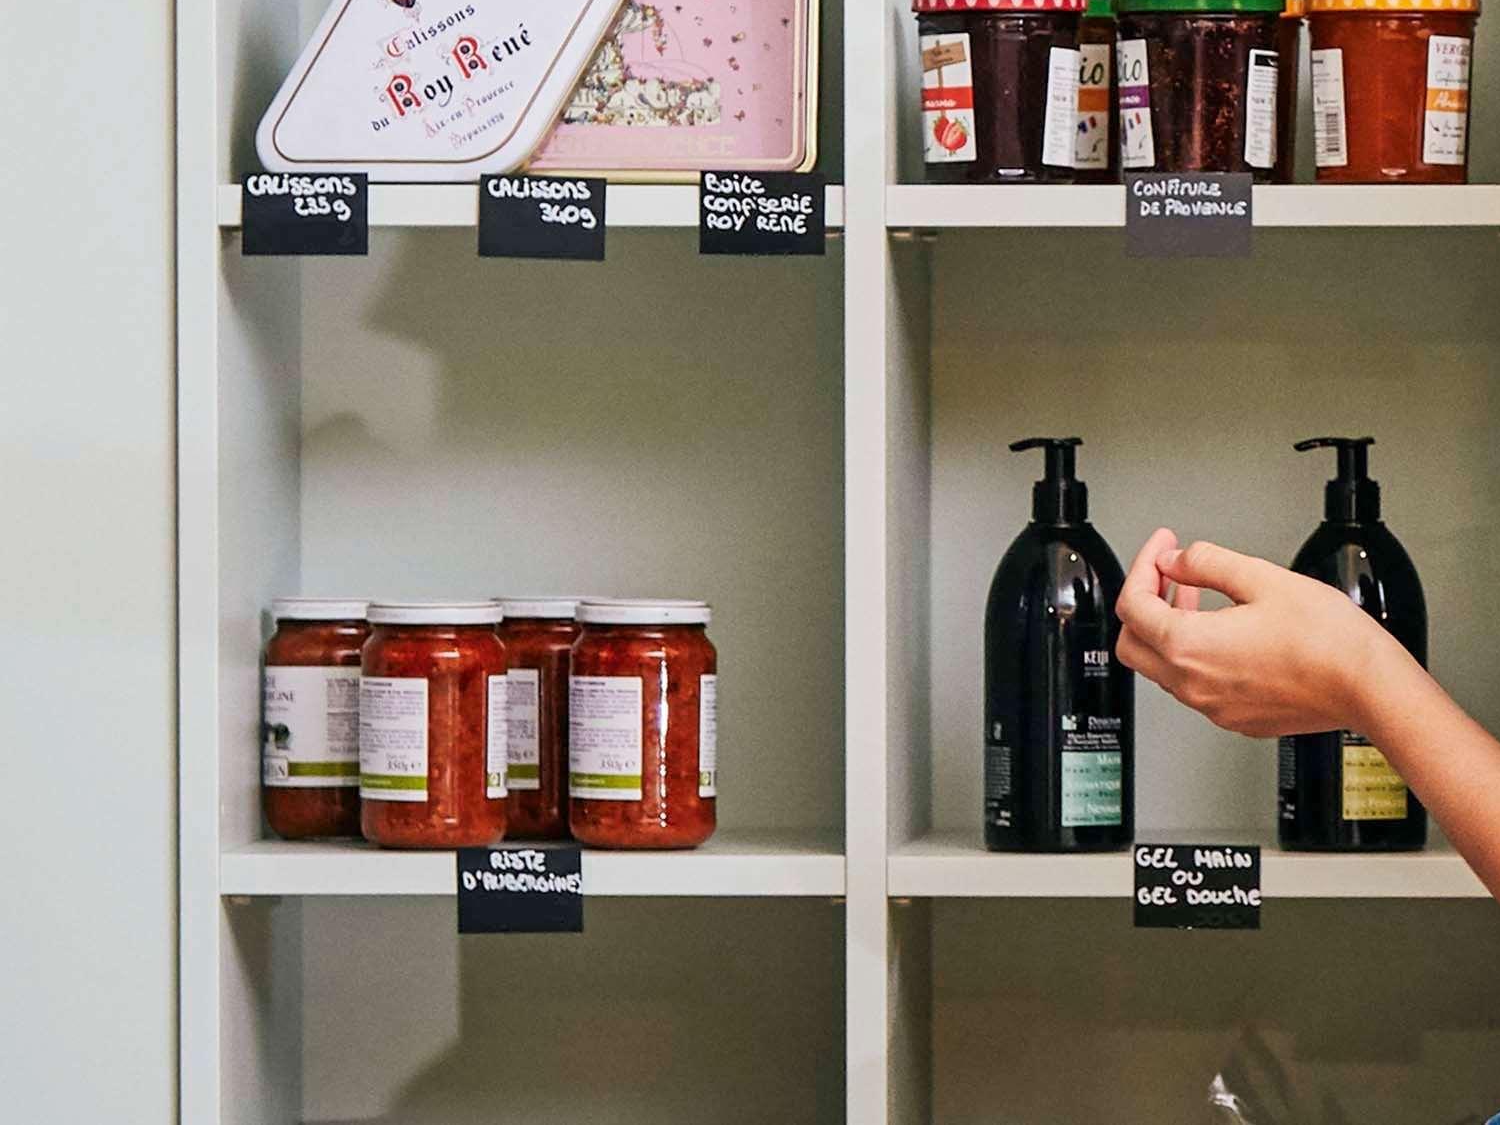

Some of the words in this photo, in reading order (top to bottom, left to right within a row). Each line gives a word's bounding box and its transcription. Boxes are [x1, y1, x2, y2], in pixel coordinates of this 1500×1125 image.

[385, 3, 477, 59] Calissons
[384, 73, 454, 118] Roy
[450, 22, 534, 80] René
[1079, 57, 1105, 85] io
[1139, 200, 1161, 217] DE
[1164, 197, 1248, 216] PROVENCE
[706, 212, 747, 232] ROY
[489, 849, 546, 872] RISTE
[1135, 846, 1179, 868] GEL
[1193, 847, 1253, 869] MAIN
[1171, 869, 1204, 885] OU
[1137, 886, 1178, 906] GEL
